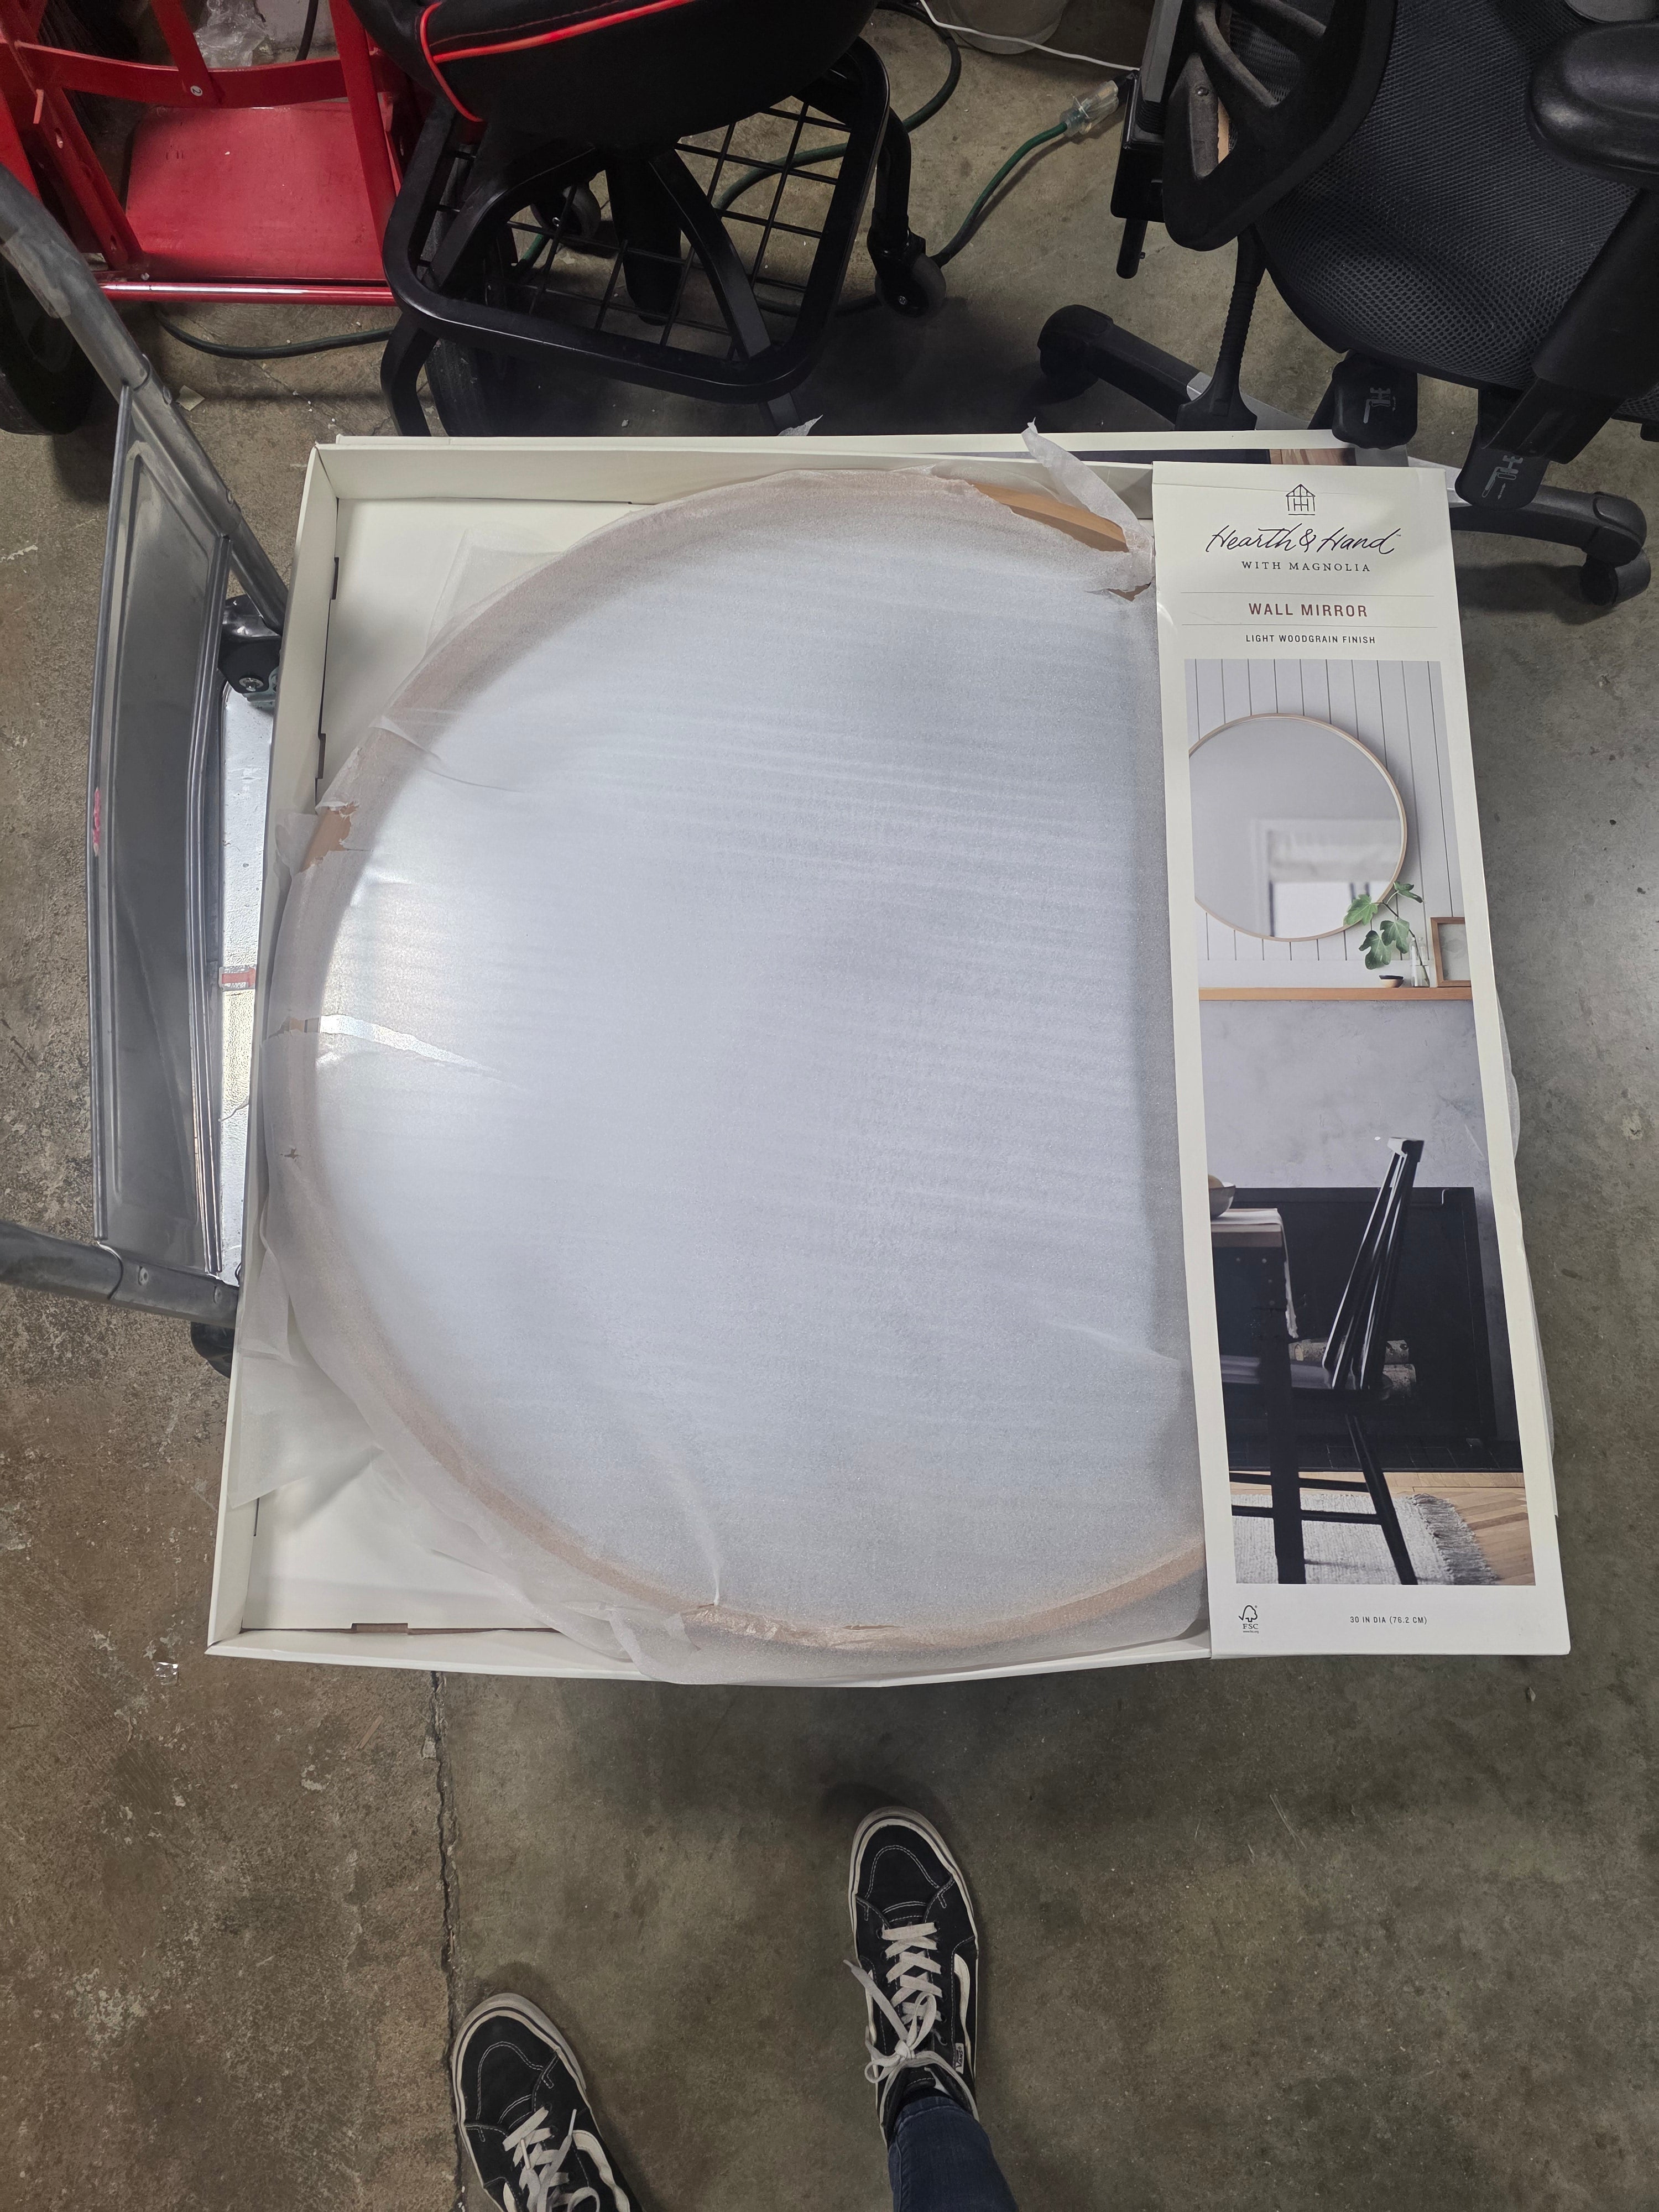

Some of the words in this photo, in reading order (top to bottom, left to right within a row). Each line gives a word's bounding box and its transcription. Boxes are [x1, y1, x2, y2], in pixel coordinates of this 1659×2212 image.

[1205, 523, 1303, 552] Hearth
[1299, 528, 1317, 553] &
[1241, 561, 1282, 570] WITH
[1288, 562, 1371, 572] MAGNOLIA
[1248, 603, 1293, 615] WALL
[1301, 604, 1368, 617] MIRROR
[1245, 634, 1275, 643] LIGHT
[1279, 635, 1338, 643] WOODGRAIN
[1389, 1615, 1410, 1625] (76.2
[1412, 1616, 1427, 1625] CM)
